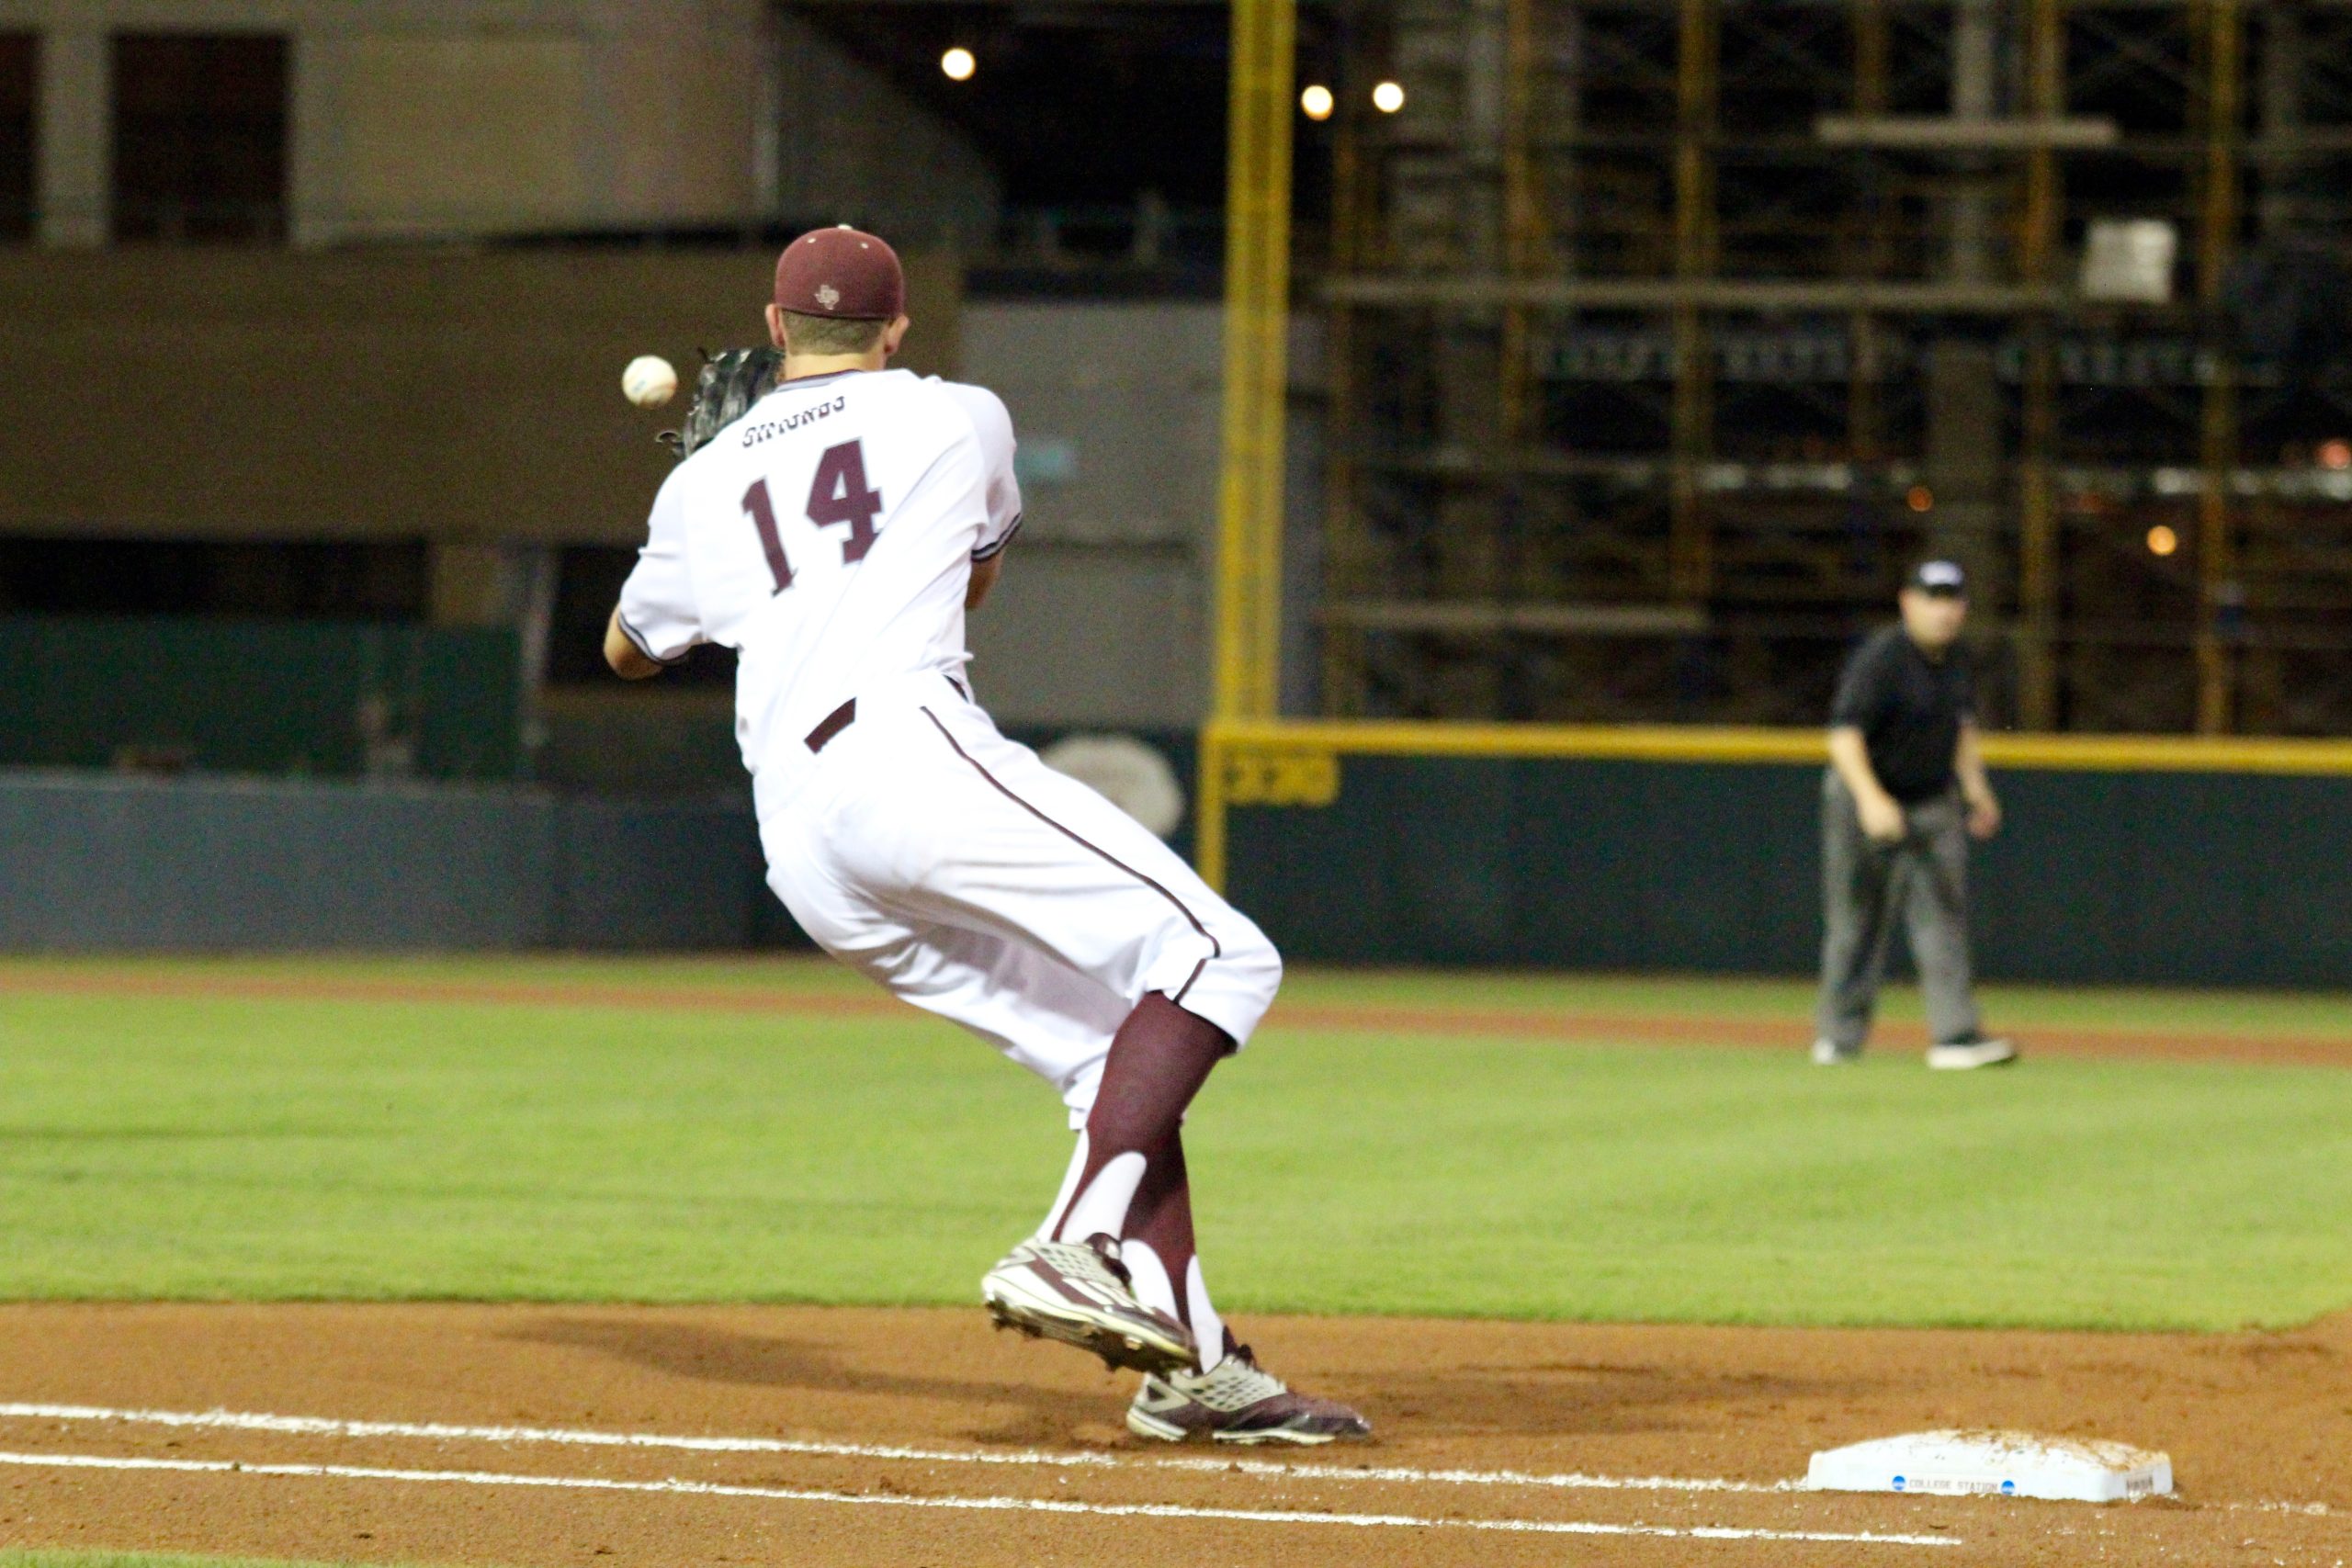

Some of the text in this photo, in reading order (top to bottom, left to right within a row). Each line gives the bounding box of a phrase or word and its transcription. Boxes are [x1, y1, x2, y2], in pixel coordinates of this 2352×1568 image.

[740, 436, 884, 598] 14
[1909, 1479, 1951, 1490] COLLEGE
[1957, 1481, 1998, 1493] STATION
